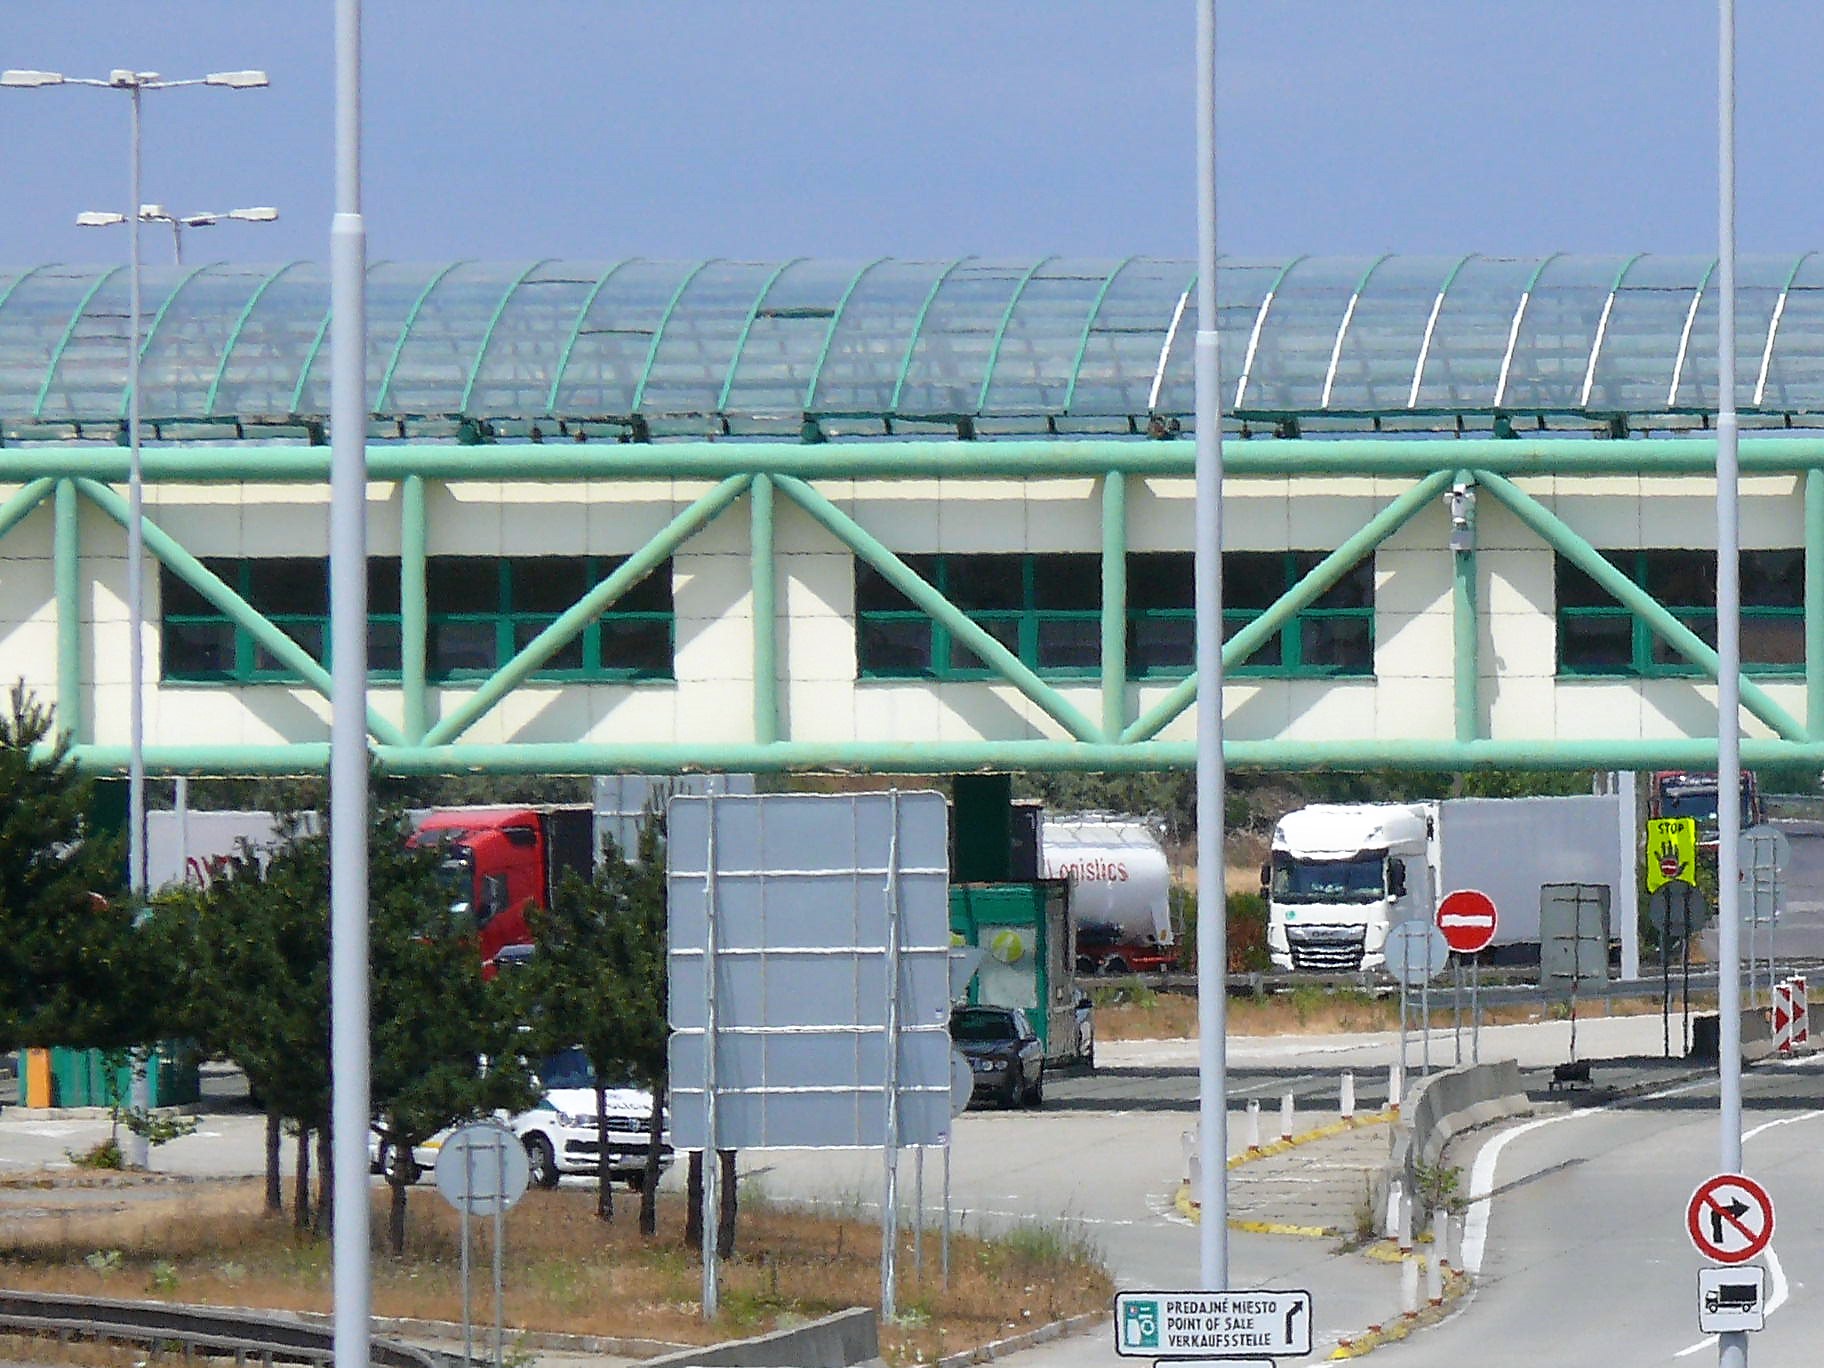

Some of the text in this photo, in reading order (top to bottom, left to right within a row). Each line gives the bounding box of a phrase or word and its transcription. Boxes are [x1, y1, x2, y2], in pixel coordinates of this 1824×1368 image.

[1658, 822, 1684, 834] STOP
[1166, 1298, 1277, 1314] PREDAJNÉ MIESTO
[1167, 1317, 1254, 1331] POINT OF SALE
[1168, 1333, 1271, 1348] VERKAUFSSTELLE
